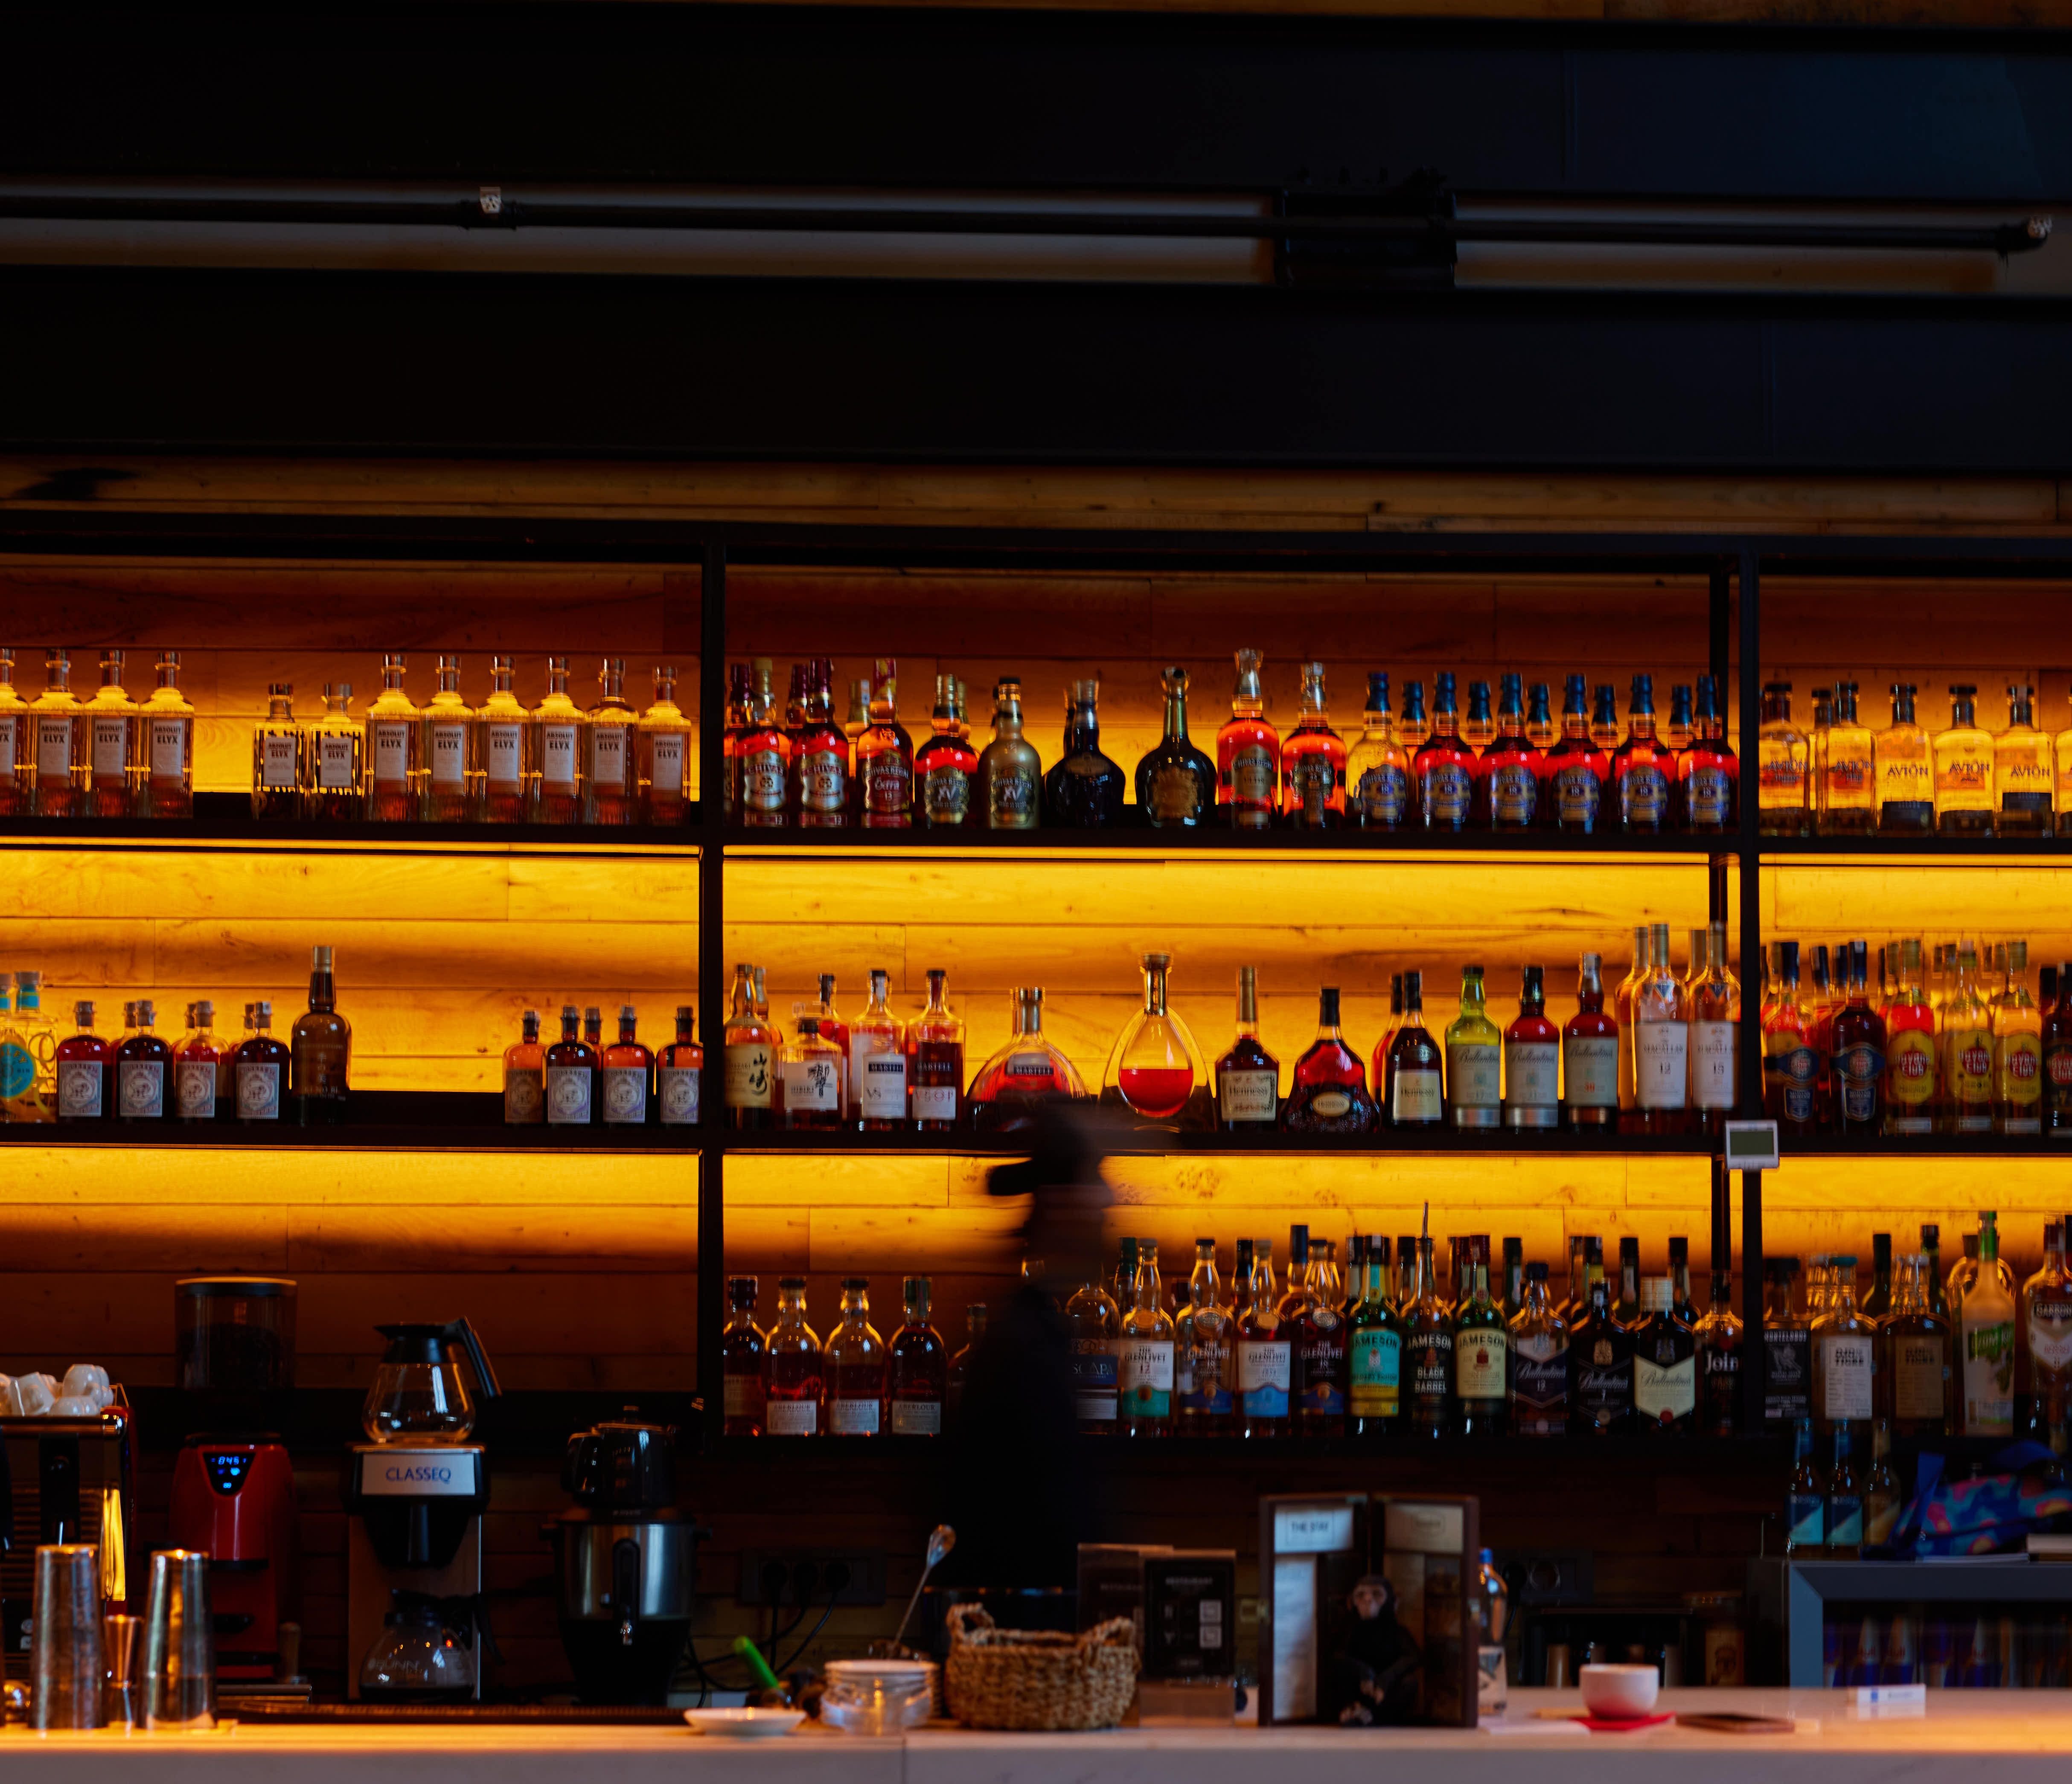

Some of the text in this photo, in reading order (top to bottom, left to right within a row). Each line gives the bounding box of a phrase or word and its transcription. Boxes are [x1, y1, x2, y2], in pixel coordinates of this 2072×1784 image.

[44, 733, 64, 743] ELYX
[99, 733, 120, 743] ELYX
[157, 735, 178, 744] ELYX
[381, 739, 402, 748] ELYX
[438, 739, 458, 749] ELYX
[494, 739, 515, 749] ELYX
[550, 740, 570, 750] ELYX
[599, 741, 619, 751] ELYX
[658, 749, 678, 758] ELYX
[748, 763, 783, 776] CHIVAS
[806, 763, 843, 776] CHIVAS
[2037, 1303, 2072, 1318] GARRON
[1352, 1334, 1398, 1351] JAMESON
[1407, 1334, 1452, 1351] JAMESON
[1458, 1334, 1505, 1351] JAMESON
[1125, 1353, 1166, 1363] GLENLIVET
[1187, 1347, 1229, 1359] GLENLIVET
[1248, 1353, 1286, 1364] GLENLIVET
[1301, 1348, 1342, 1360] GLENLIVET
[1417, 1366, 1445, 1378] BLACK
[1414, 1380, 1447, 1393] BARREL
[386, 1467, 451, 1484] CLASSEQ
